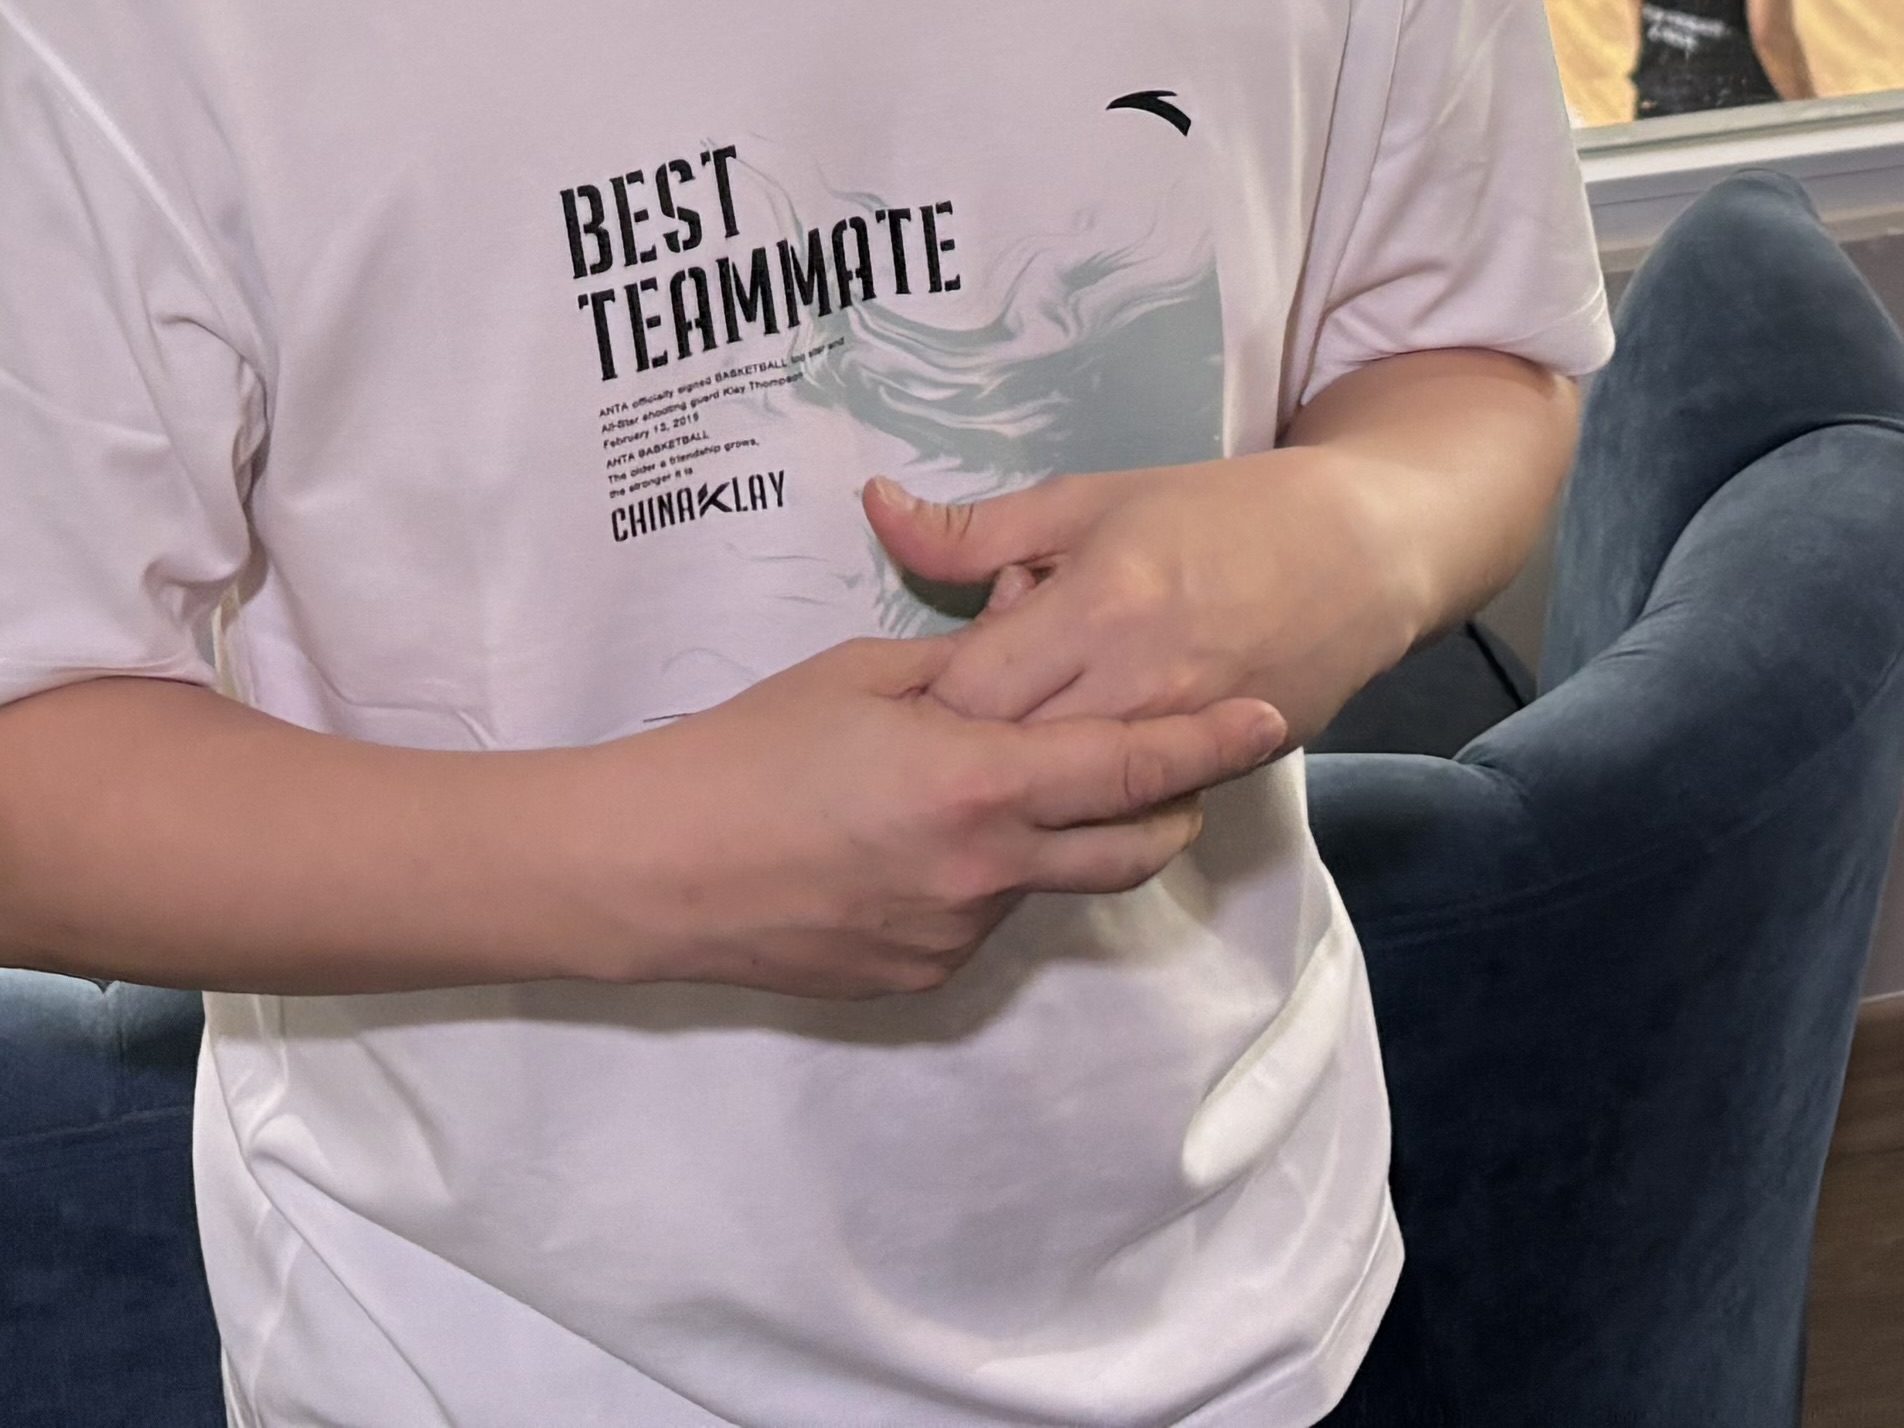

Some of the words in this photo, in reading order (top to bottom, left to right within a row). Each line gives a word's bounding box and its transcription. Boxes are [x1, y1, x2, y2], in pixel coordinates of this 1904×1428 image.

[559, 145, 738, 279] BEST
[578, 200, 962, 381] TEAMMATE
[599, 402, 629, 417] ANTA
[632, 390, 673, 408] officially
[677, 376, 711, 393] signed
[715, 358, 788, 382] BASKETBALL
[828, 336, 845, 350] and
[602, 417, 639, 433] All-Star
[642, 402, 687, 421] shooting
[690, 390, 719, 408] guard
[723, 386, 746, 397] Klay
[749, 372, 804, 390] Thompson
[603, 431, 649, 450] February
[606, 454, 635, 469] ANTA
[638, 430, 710, 458] BASKETBALL
[608, 471, 627, 484] The
[630, 464, 656, 477] older
[660, 460, 666, 468] a
[669, 444, 721, 465] friendship
[724, 438, 760, 452] grows,
[609, 487, 626, 499] the
[629, 474, 671, 492] stronger
[684, 467, 693, 475] is
[611, 470, 785, 542] CHINAKLAY
